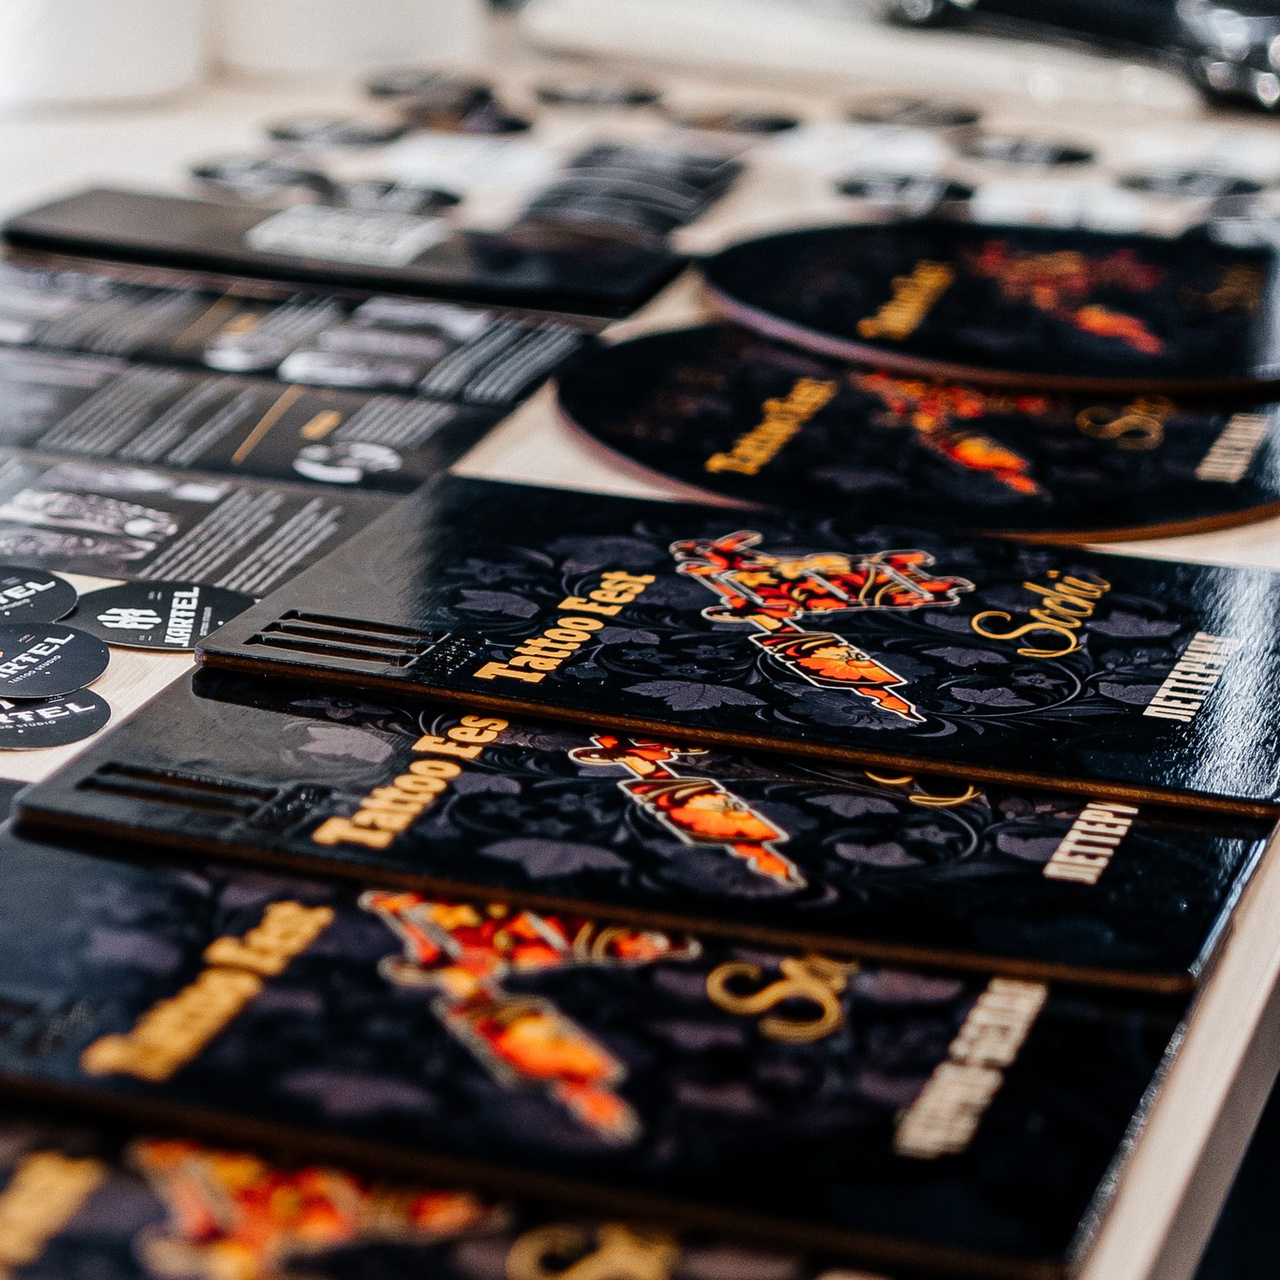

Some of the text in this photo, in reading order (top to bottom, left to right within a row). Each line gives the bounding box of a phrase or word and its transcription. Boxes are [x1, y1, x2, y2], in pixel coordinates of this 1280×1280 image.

[164, 586, 200, 648] KARTEL
[473, 571, 656, 683] Tattoo Fest
[971, 570, 1111, 658] Sochi
[311, 715, 509, 850] Tattoo Fes
